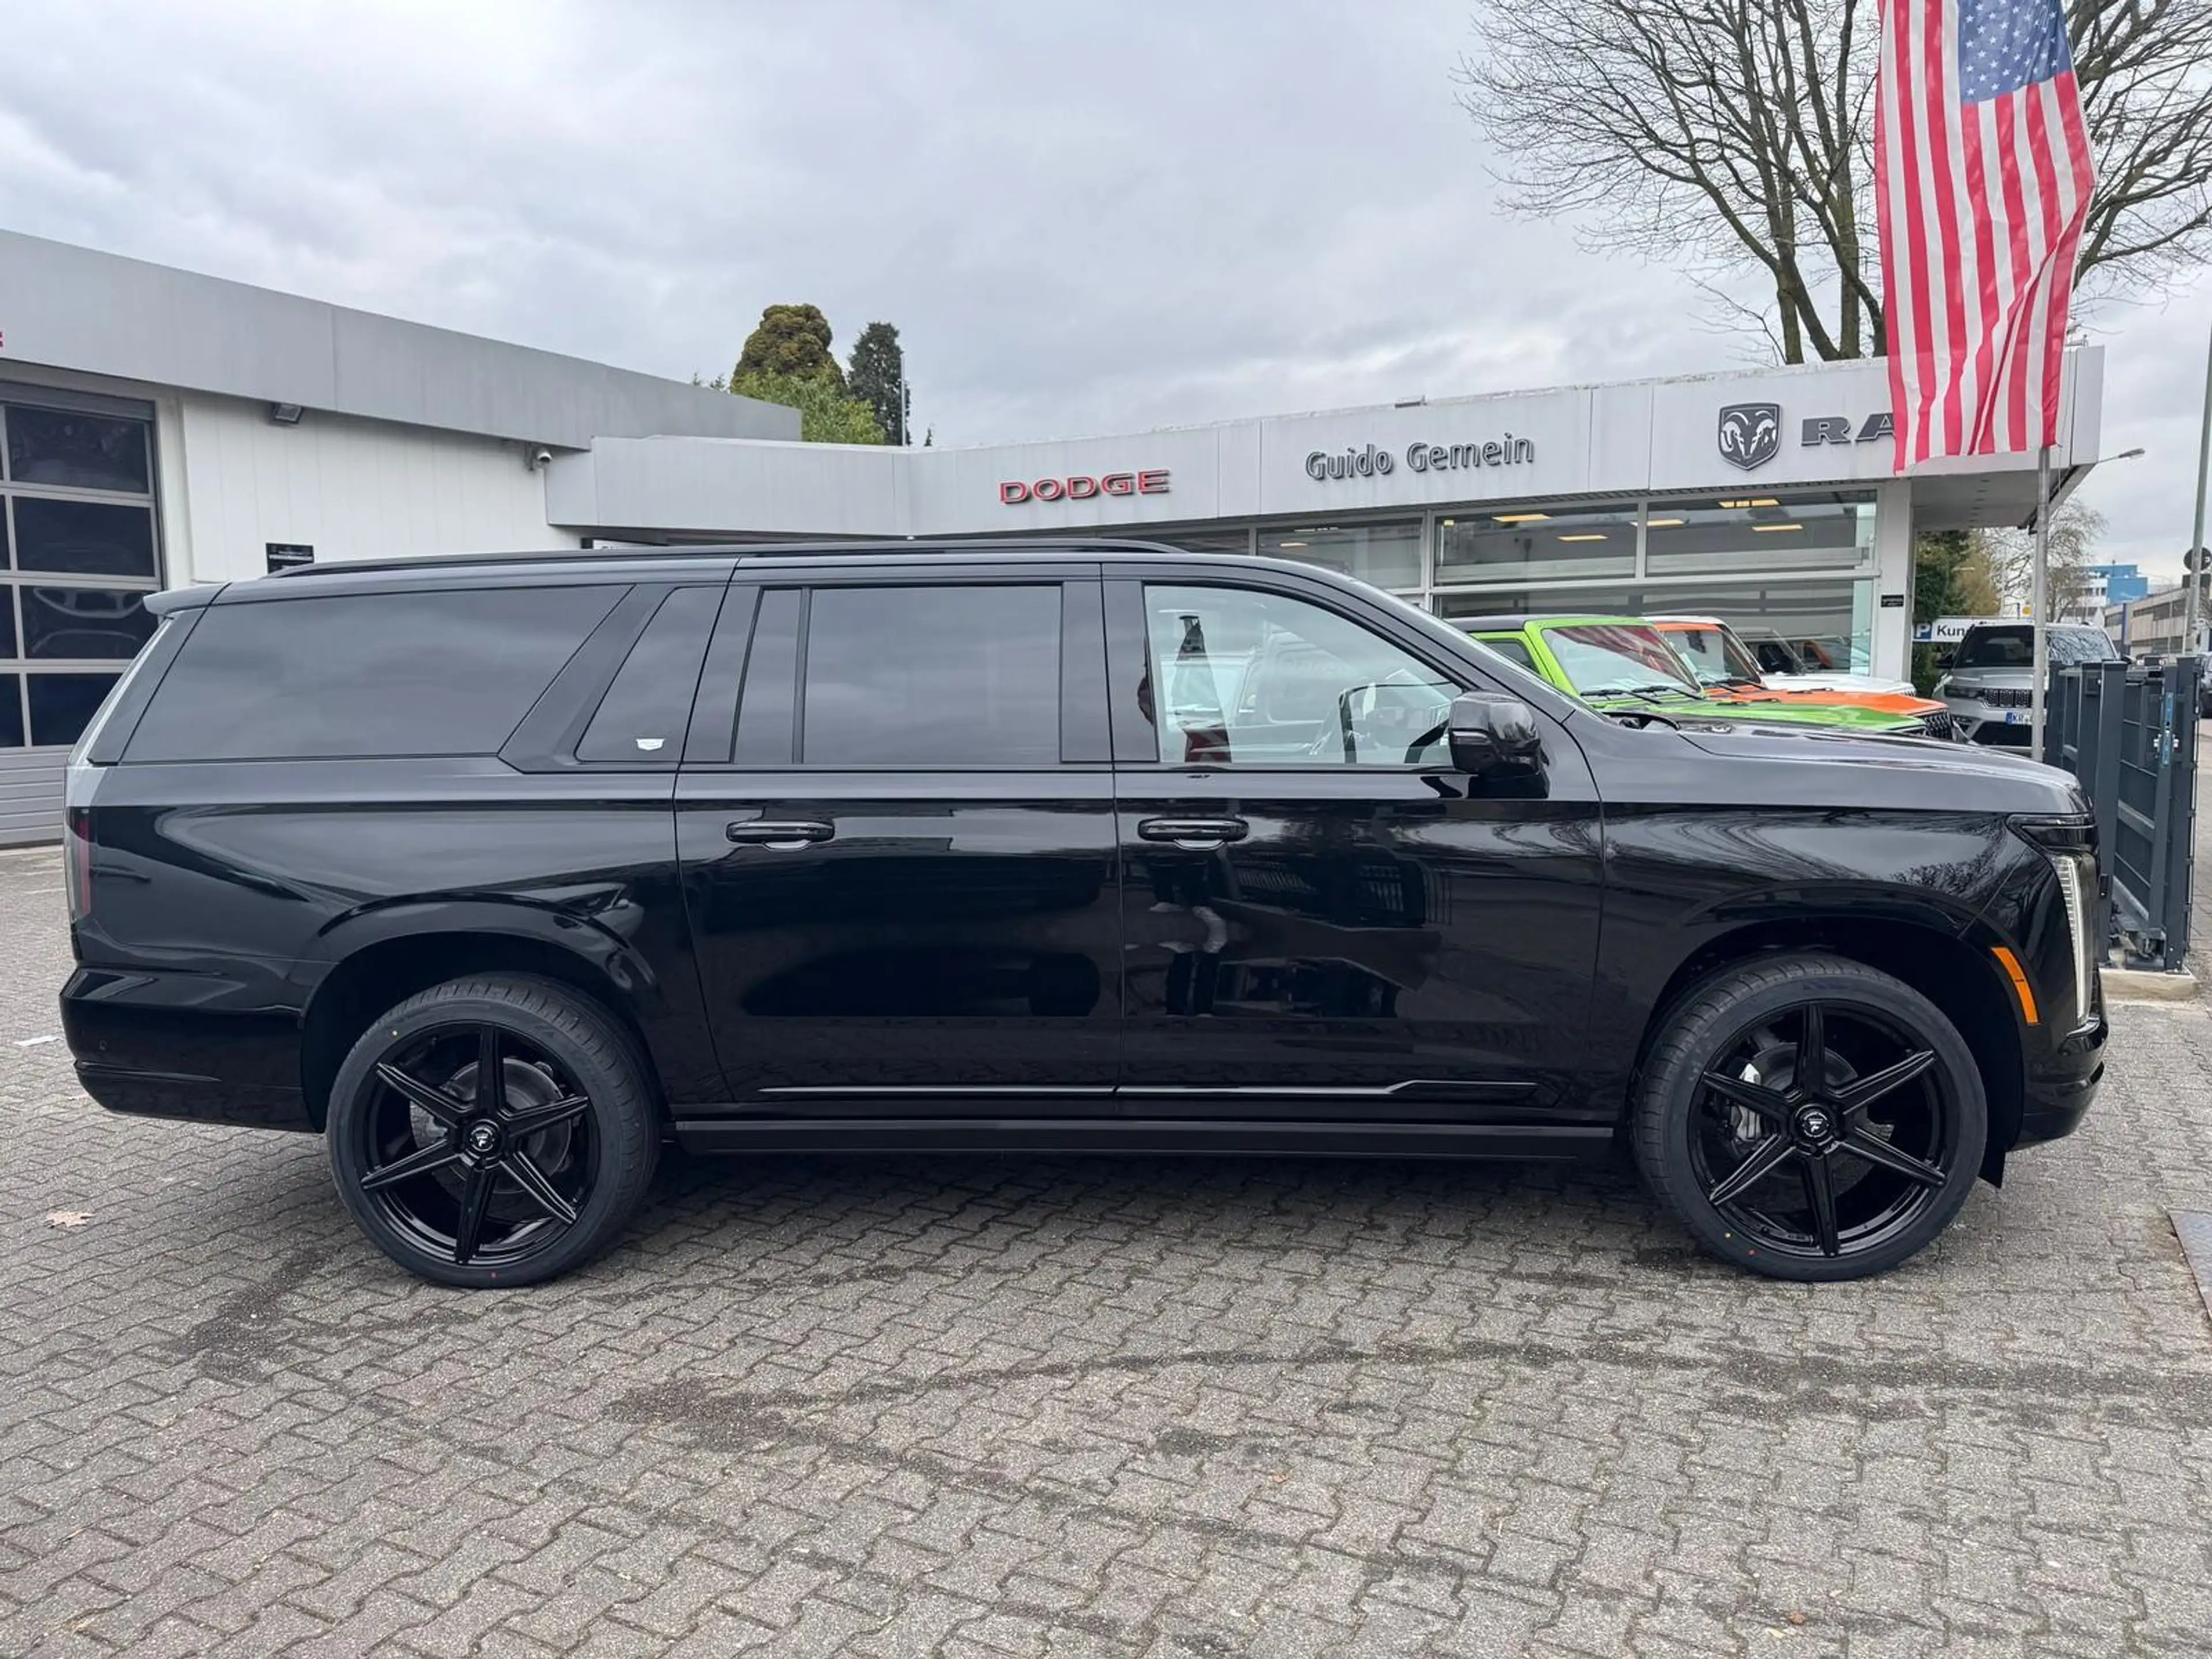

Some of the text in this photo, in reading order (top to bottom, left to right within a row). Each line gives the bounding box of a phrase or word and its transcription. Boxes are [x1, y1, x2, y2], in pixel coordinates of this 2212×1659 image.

[1801, 412, 1896, 447] RA
[1306, 432, 1533, 480] Guido Gemein
[999, 469, 1170, 504] DODGE
[1915, 623, 1965, 638] P Kun
